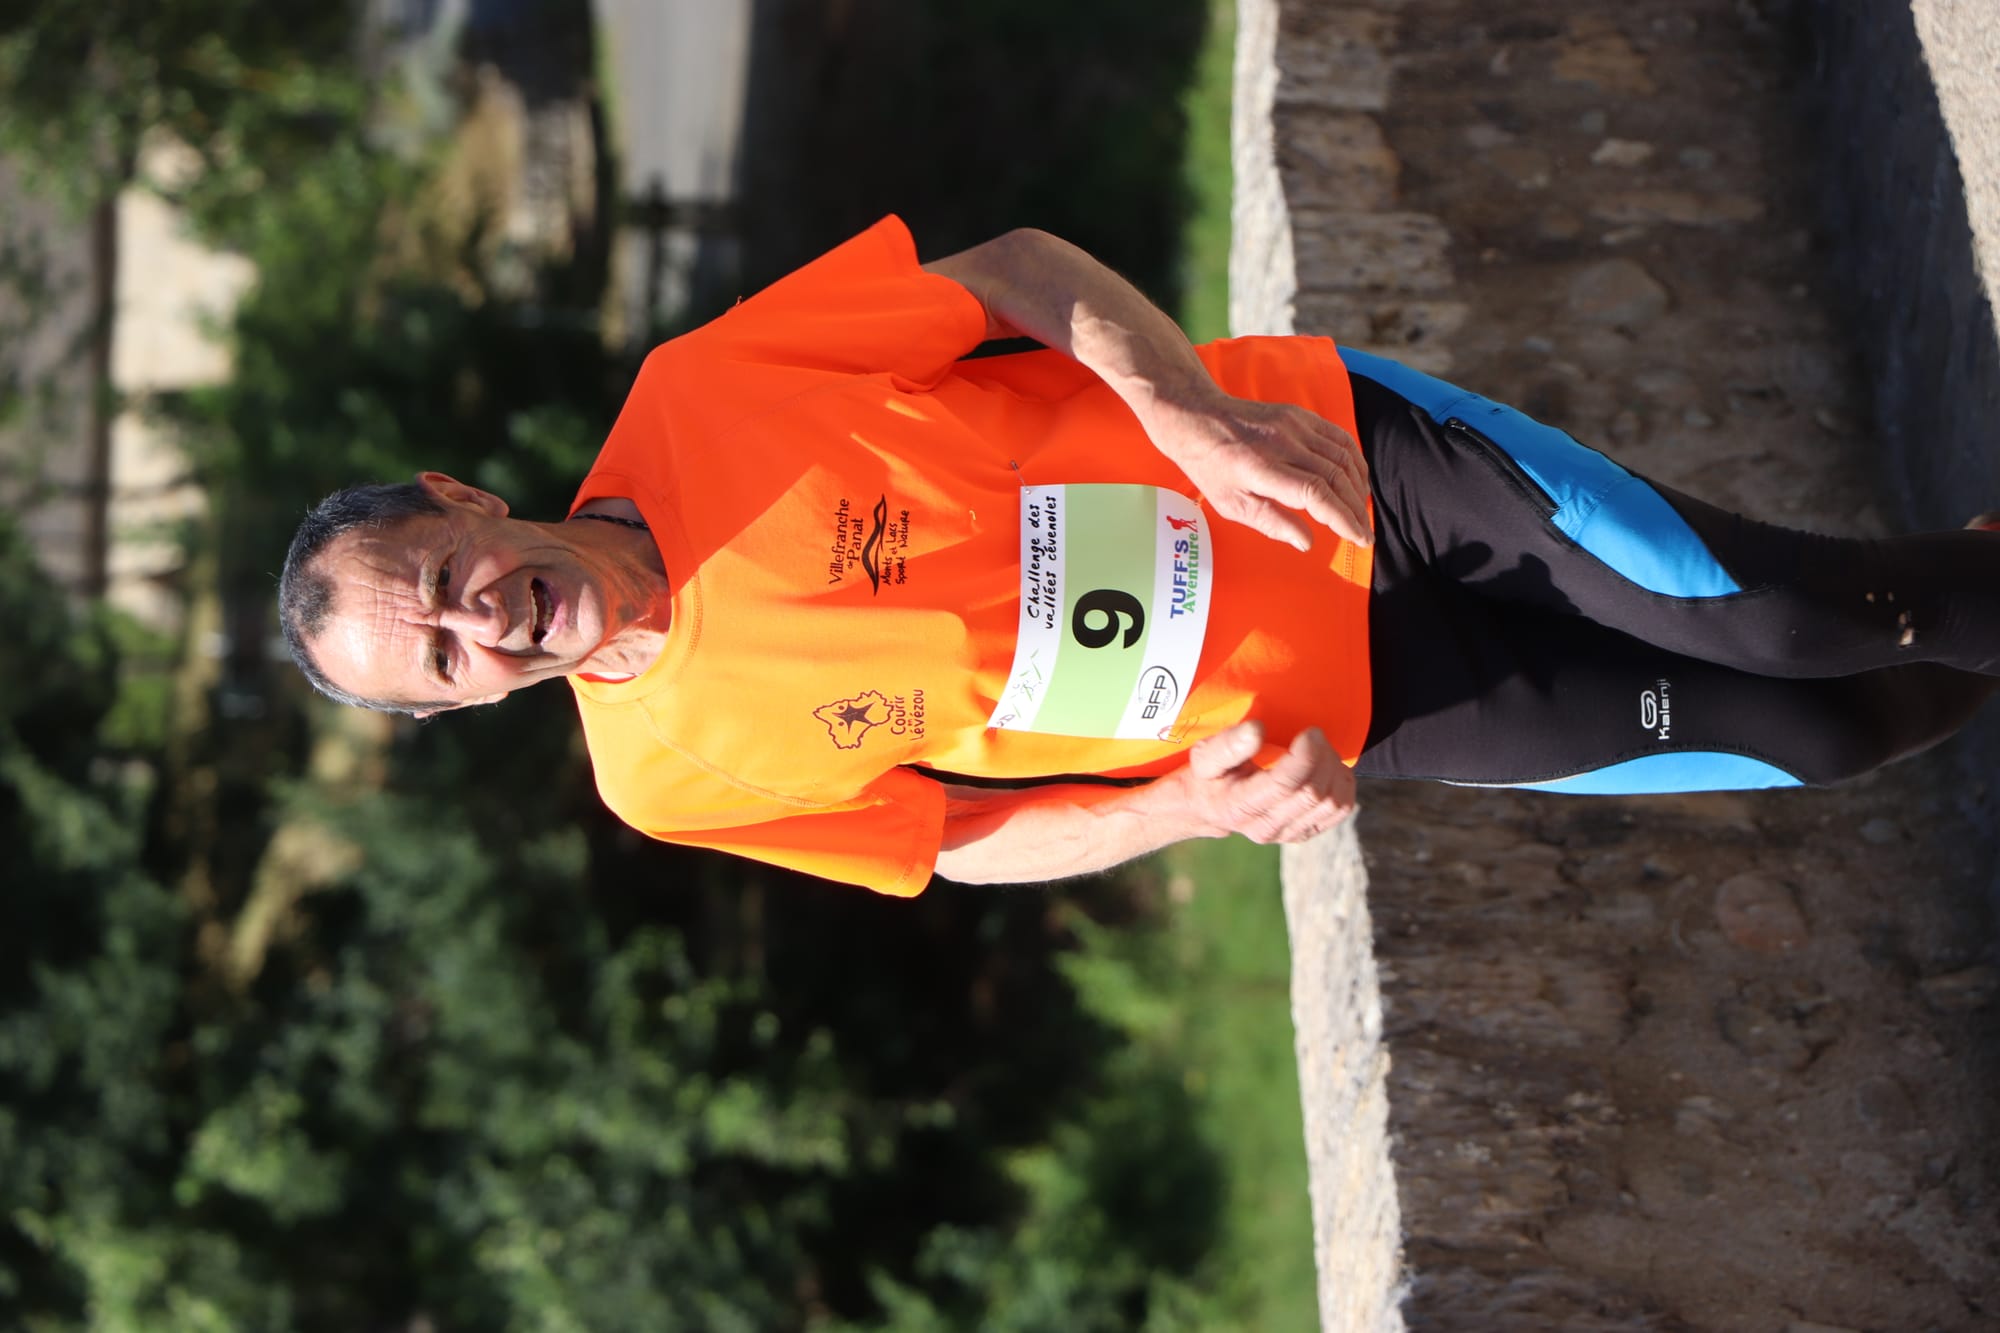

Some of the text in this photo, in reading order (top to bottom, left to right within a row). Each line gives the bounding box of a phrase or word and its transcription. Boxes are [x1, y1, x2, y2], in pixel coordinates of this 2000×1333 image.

[828, 498, 850, 585] Villefranche
[847, 518, 864, 569] de Panat
[885, 522, 898, 543] Lacs
[1027, 504, 1046, 619] Challenge des
[1040, 495, 1057, 630] vallées cévenoles
[880, 556, 893, 586] Monts
[1169, 539, 1190, 619] TUFF'S
[1182, 532, 1200, 613] Aventure
[1072, 588, 1145, 650] 9
[890, 695, 906, 735] Courir
[1141, 674, 1169, 720] BFP
[1656, 679, 1671, 740] Kalenji
